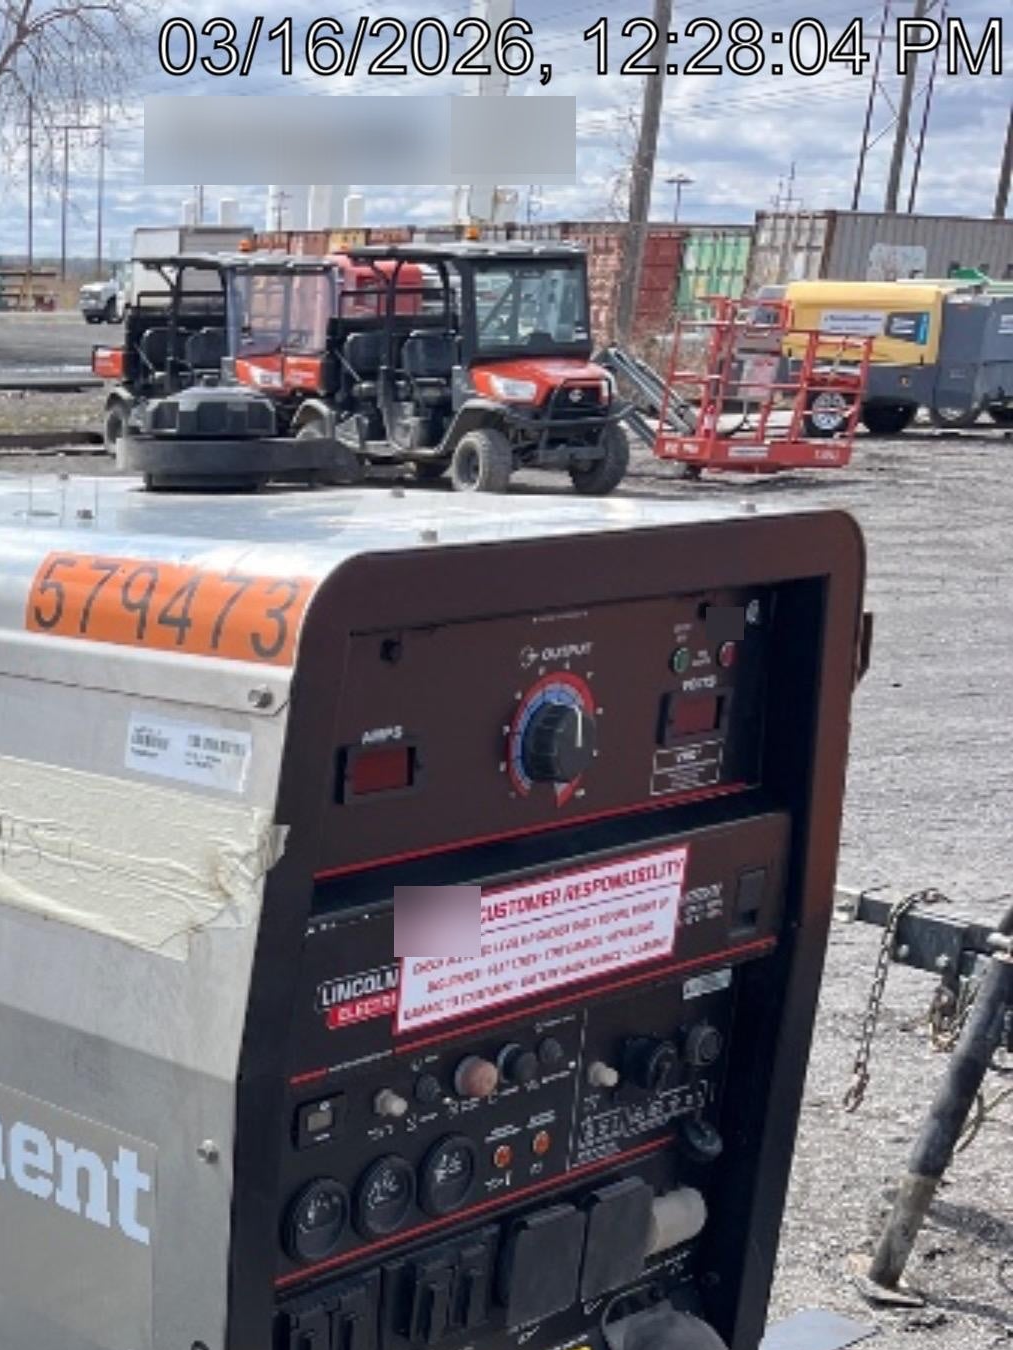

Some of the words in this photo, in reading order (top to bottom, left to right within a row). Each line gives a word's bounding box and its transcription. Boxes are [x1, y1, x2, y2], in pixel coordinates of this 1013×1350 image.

[34, 557, 302, 659] 579473
[542, 642, 594, 662] OUTPUT
[362, 725, 403, 745] AMPS
[322, 967, 399, 1006] LINCOLN
